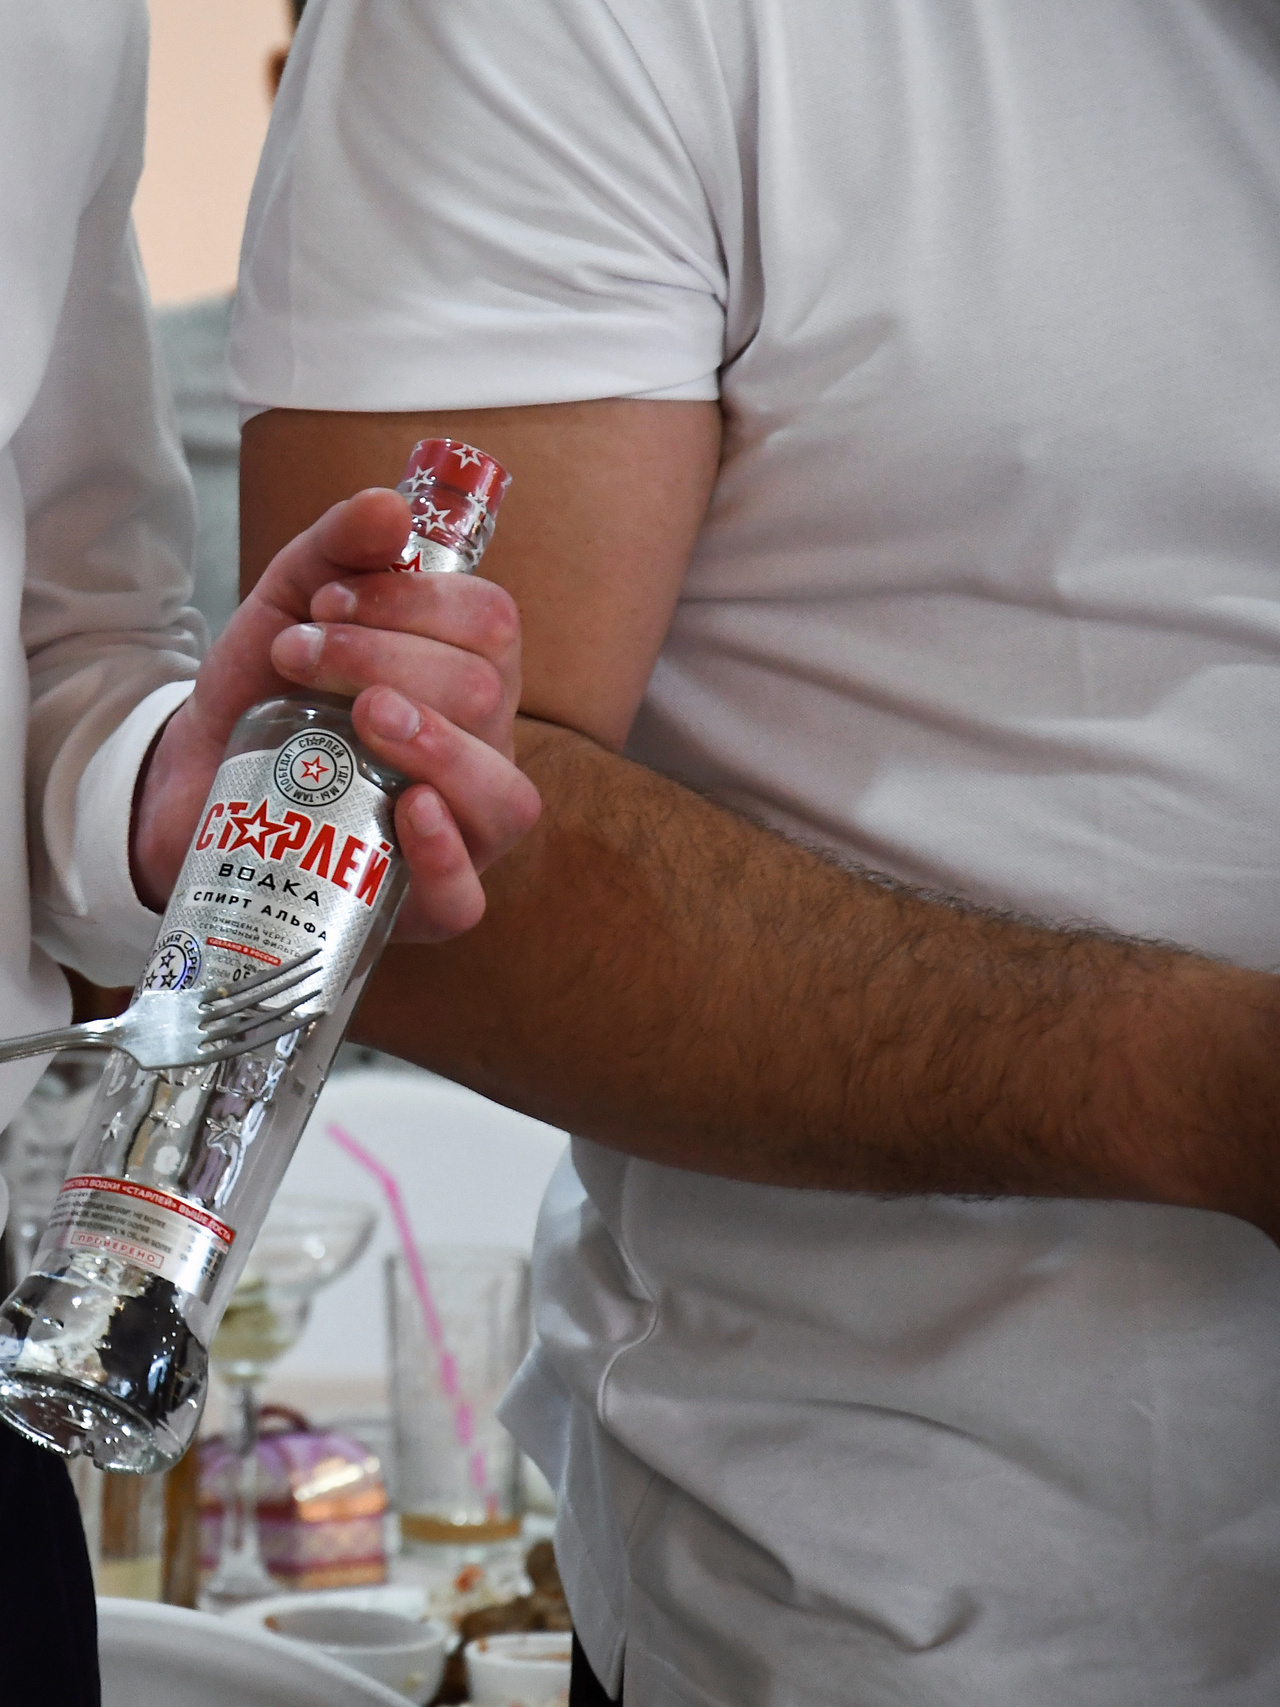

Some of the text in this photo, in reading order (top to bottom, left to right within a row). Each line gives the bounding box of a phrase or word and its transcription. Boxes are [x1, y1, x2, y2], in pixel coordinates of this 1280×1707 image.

[278, 748, 296, 792] ПОБЕДА!
[336, 765, 349, 786] ГДЕ
[293, 788, 315, 802] ТАМ
[218, 862, 320, 907] ВОДКА
[193, 891, 327, 941] СПИРТ АЛЬФА
[211, 916, 292, 945] ОЧИЩЕНА ЧЕРЕЗ
[208, 937, 243, 951] СДЕЛАНО
[250, 950, 279, 964] РОССИИ
[89, 1179, 121, 1191] ВОДКИ
[178, 1204, 209, 1226] ВЫШЕ
